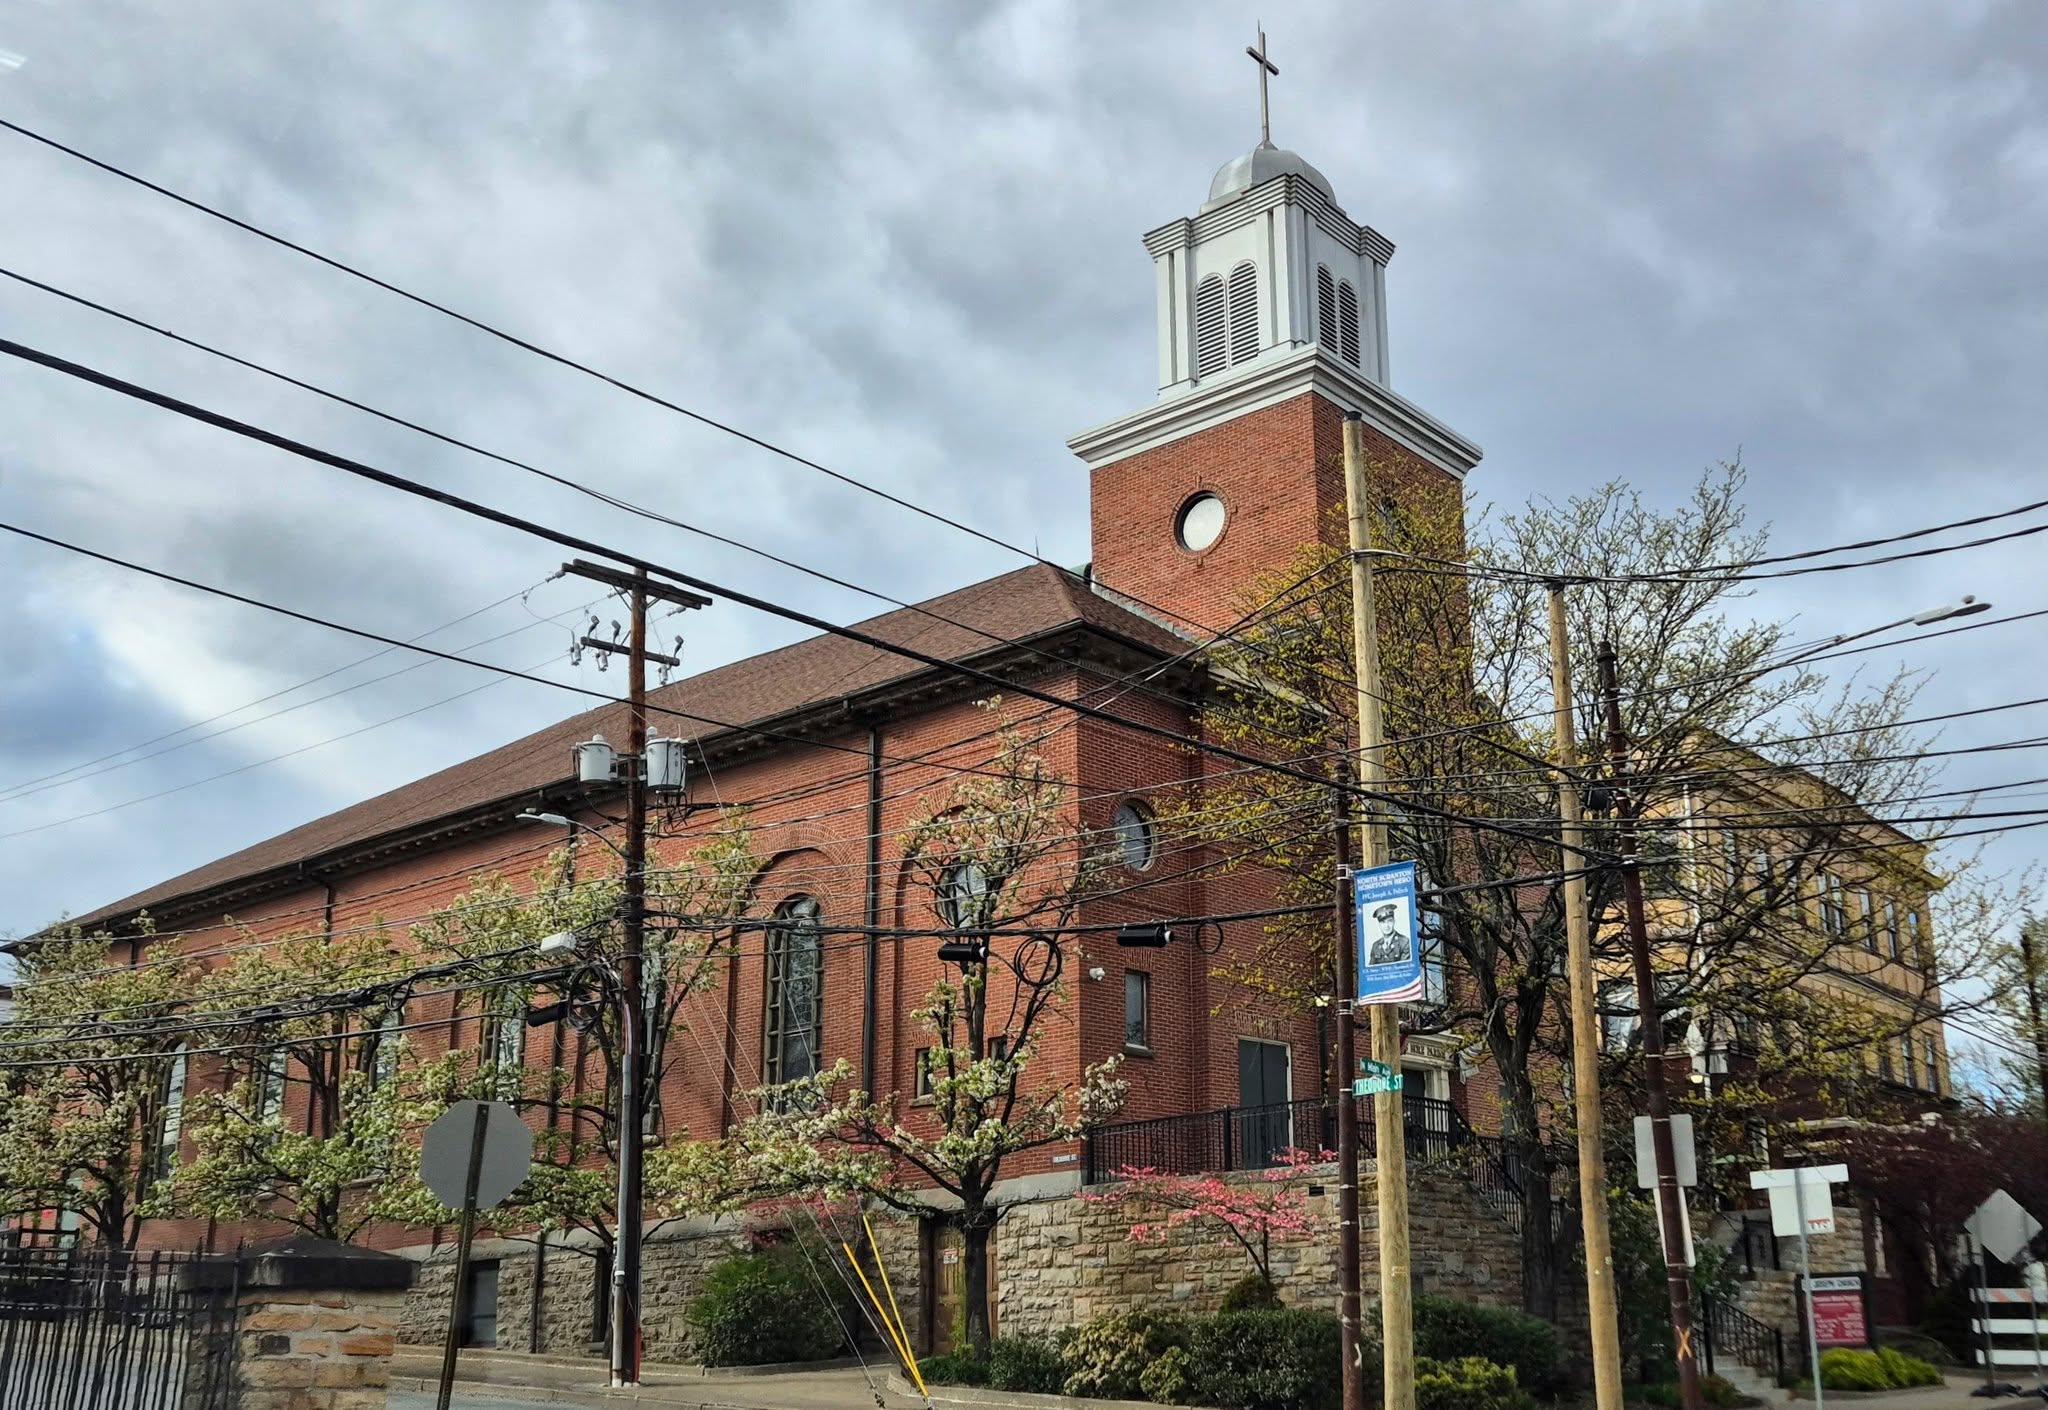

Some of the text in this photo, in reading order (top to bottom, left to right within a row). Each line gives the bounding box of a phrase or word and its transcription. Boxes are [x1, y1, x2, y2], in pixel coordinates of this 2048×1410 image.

[1357, 870, 1411, 884] NORTH SCRANTON
[1358, 876, 1411, 890] HOMETOWN HERO
[1367, 1062, 1380, 1073] Main
[1394, 1074, 1403, 1090] ST
